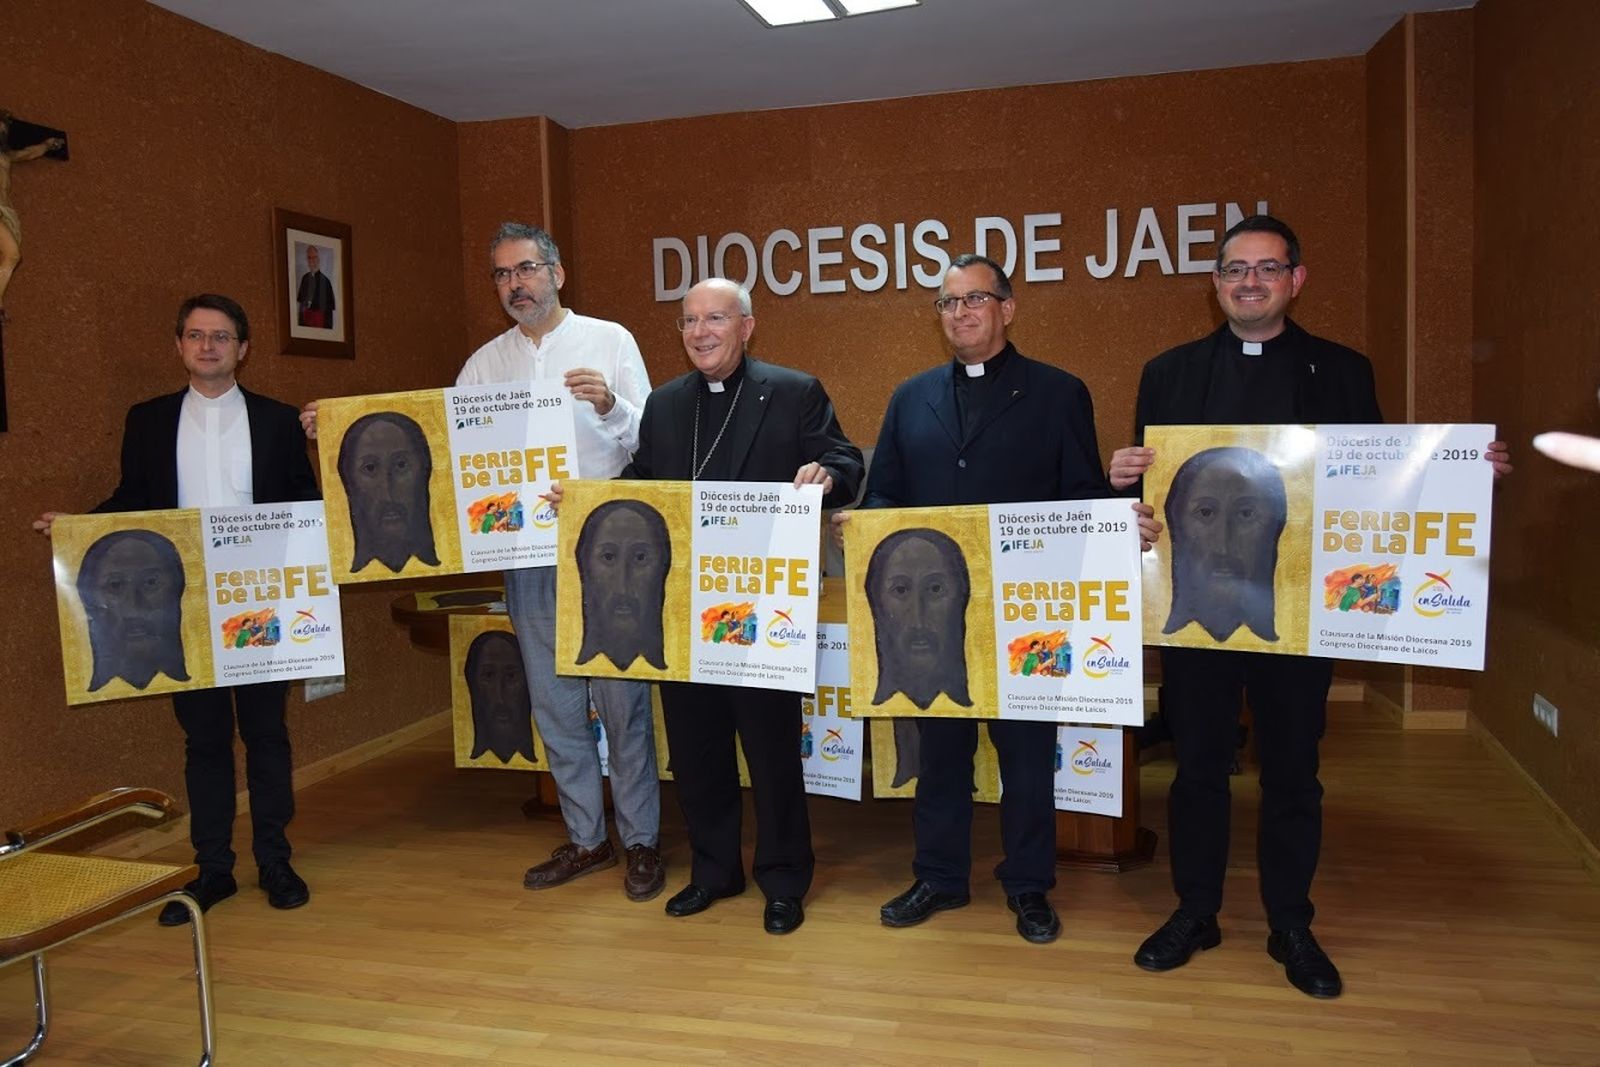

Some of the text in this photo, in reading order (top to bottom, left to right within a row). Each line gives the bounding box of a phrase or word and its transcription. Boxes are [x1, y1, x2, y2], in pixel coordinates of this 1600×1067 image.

[653, 219, 950, 301] DIOCESIS
[975, 213, 1063, 282] DE
[452, 390, 531, 405] Diócesis de Jaén
[455, 397, 562, 415] 19 de octubre de 2019
[466, 416, 493, 426] IFEJA
[1385, 436, 1401, 447] de
[1327, 449, 1343, 460] 19
[1347, 449, 1362, 460] de
[1442, 449, 1478, 460] 2019
[525, 446, 570, 482] FE
[1340, 464, 1376, 475] IFEJA
[700, 491, 780, 502] Diócesis de Jaén
[701, 503, 810, 514] 19 de octubre de 2019
[210, 511, 293, 524] Diócesis de Jaén
[711, 516, 738, 526] IFEJA
[999, 511, 1092, 524] Diócesis de Jaén
[212, 525, 224, 534] 19
[227, 524, 239, 533] de
[242, 522, 280, 532] octubre
[283, 520, 295, 529] de
[1000, 522, 1128, 536] 19 de octubre de 2019
[1414, 511, 1476, 556] FE
[223, 535, 252, 545] IFEJA
[1012, 540, 1044, 549] IFEJA
[283, 564, 329, 599] FE
[765, 558, 809, 597] FE
[1079, 581, 1130, 621] FE
[1320, 629, 1472, 647] Clausura de la Misión Diocesana 2019
[818, 641, 849, 650] de 201
[1319, 640, 1438, 655] Congreso Diocesano de Laicos
[818, 686, 851, 718] FE
[1037, 694, 1045, 702] de
[1055, 694, 1078, 702] Misión
[1079, 696, 1114, 704] Diocesana
[1115, 697, 1133, 705] 2019
[1007, 703, 1038, 711] Congreso
[1040, 704, 1073, 712] Diocesano
[1085, 706, 1107, 714] Laicos
